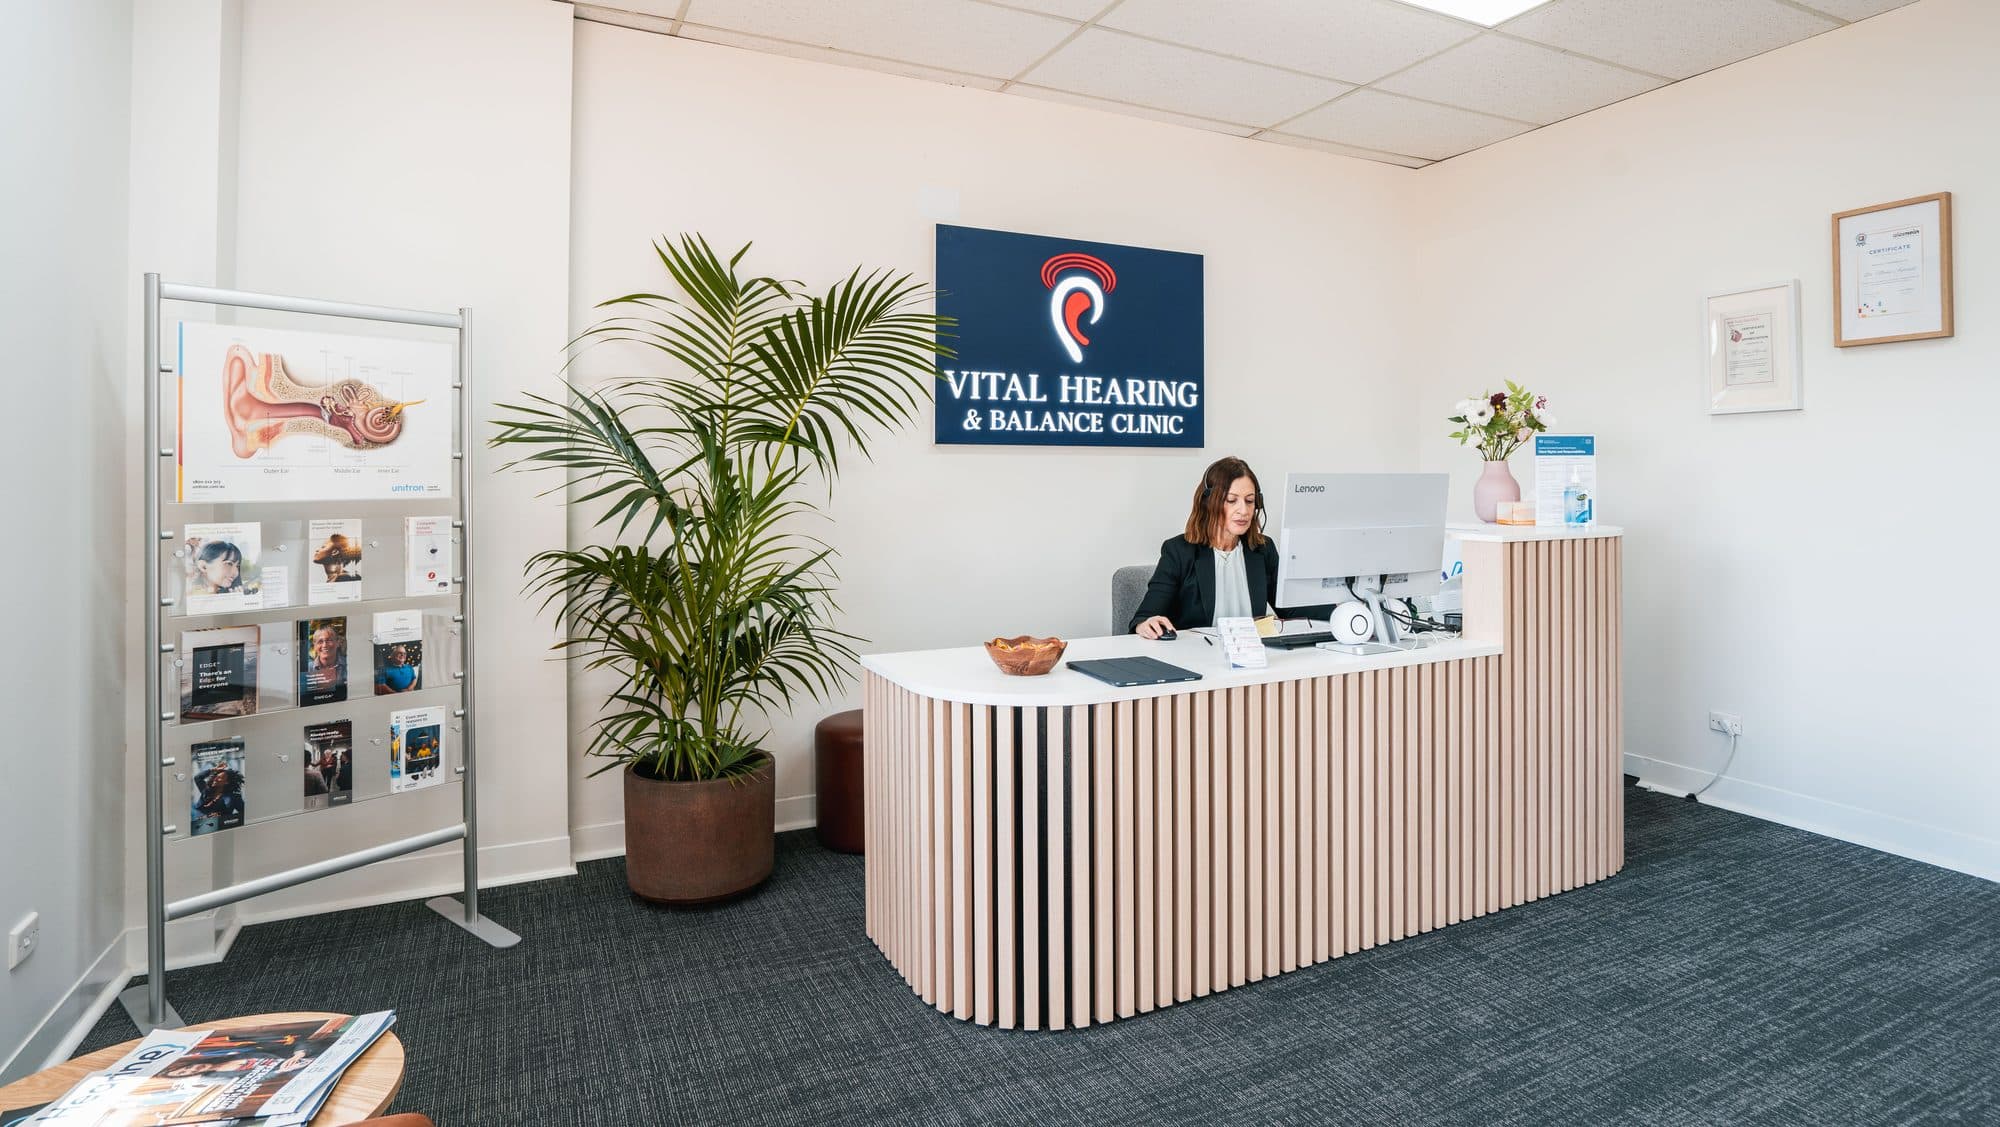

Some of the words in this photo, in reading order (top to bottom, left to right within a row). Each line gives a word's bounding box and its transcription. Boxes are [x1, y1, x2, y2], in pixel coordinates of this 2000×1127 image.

[944, 370, 1047, 402] VITAL
[1059, 375, 1199, 408] HEARING
[963, 409, 982, 431] &
[989, 410, 1104, 432] BALANCE
[1111, 414, 1184, 434] CLINIC
[391, 483, 424, 492] unitron
[1295, 484, 1325, 493] Lenovo
